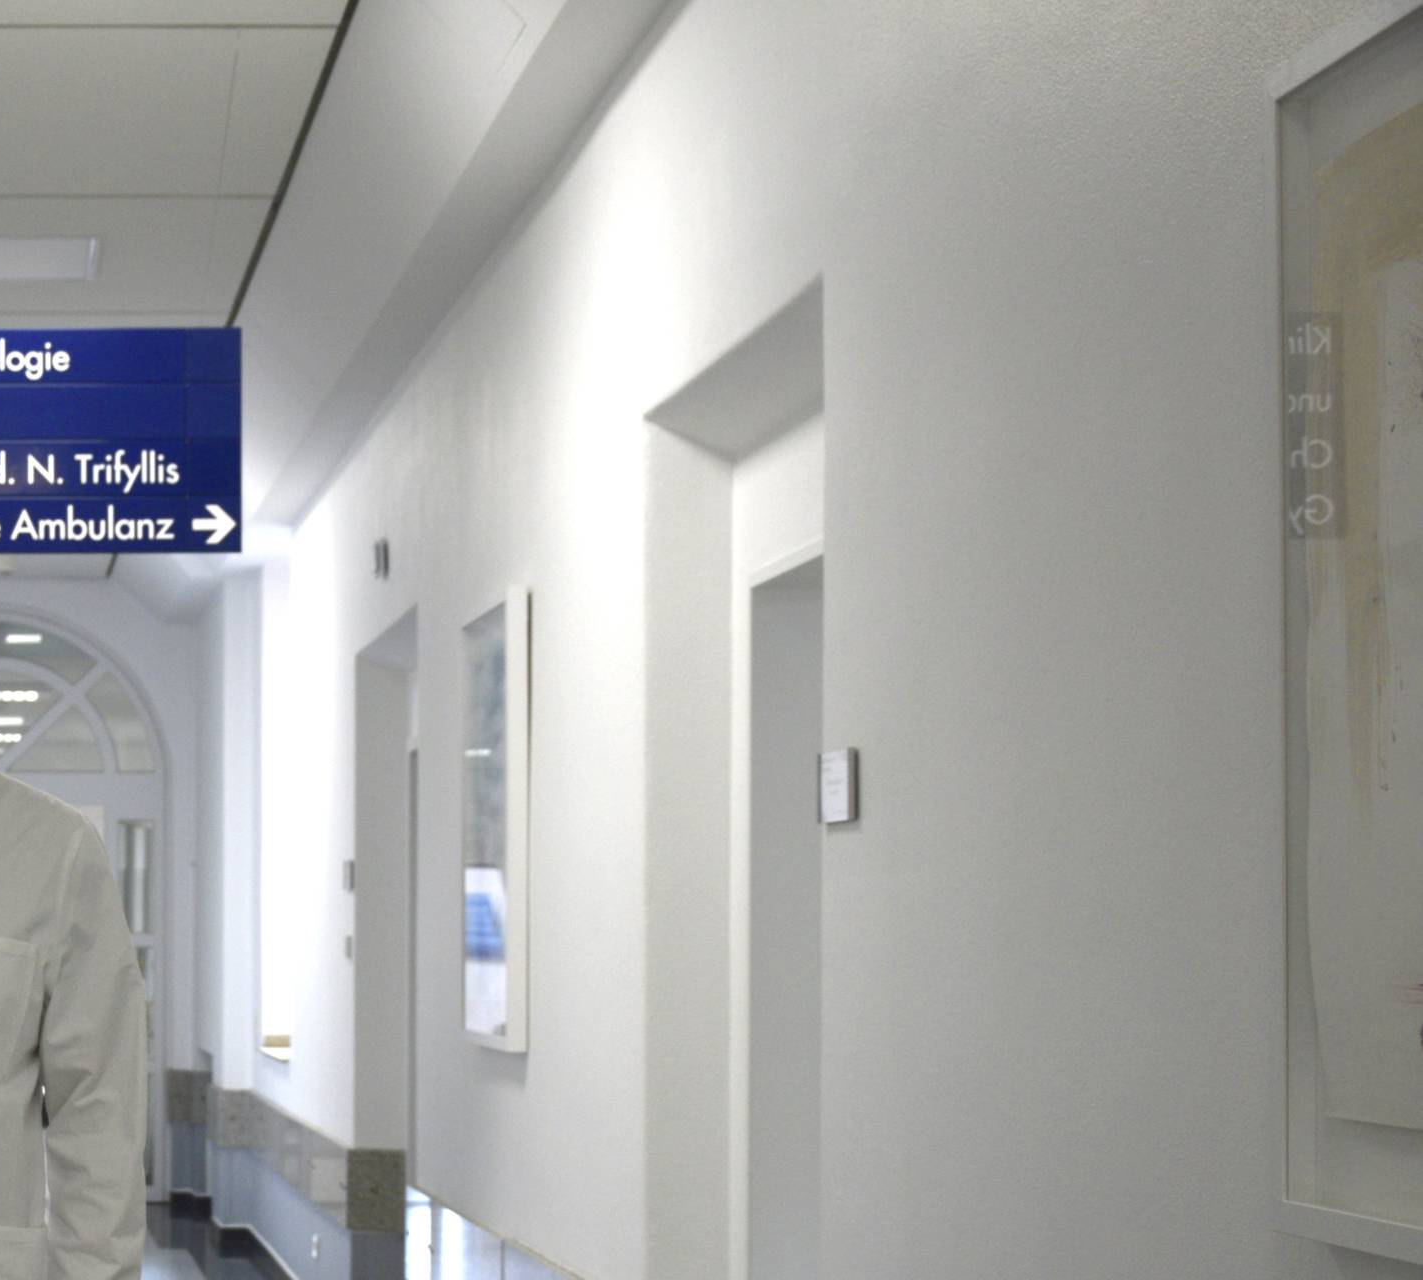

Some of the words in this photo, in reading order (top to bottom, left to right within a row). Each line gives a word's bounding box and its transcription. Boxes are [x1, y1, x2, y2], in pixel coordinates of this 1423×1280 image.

[26, 453, 64, 486] N.
[73, 449, 181, 494] Trifyllis
[10, 503, 176, 541] Ambulanz
